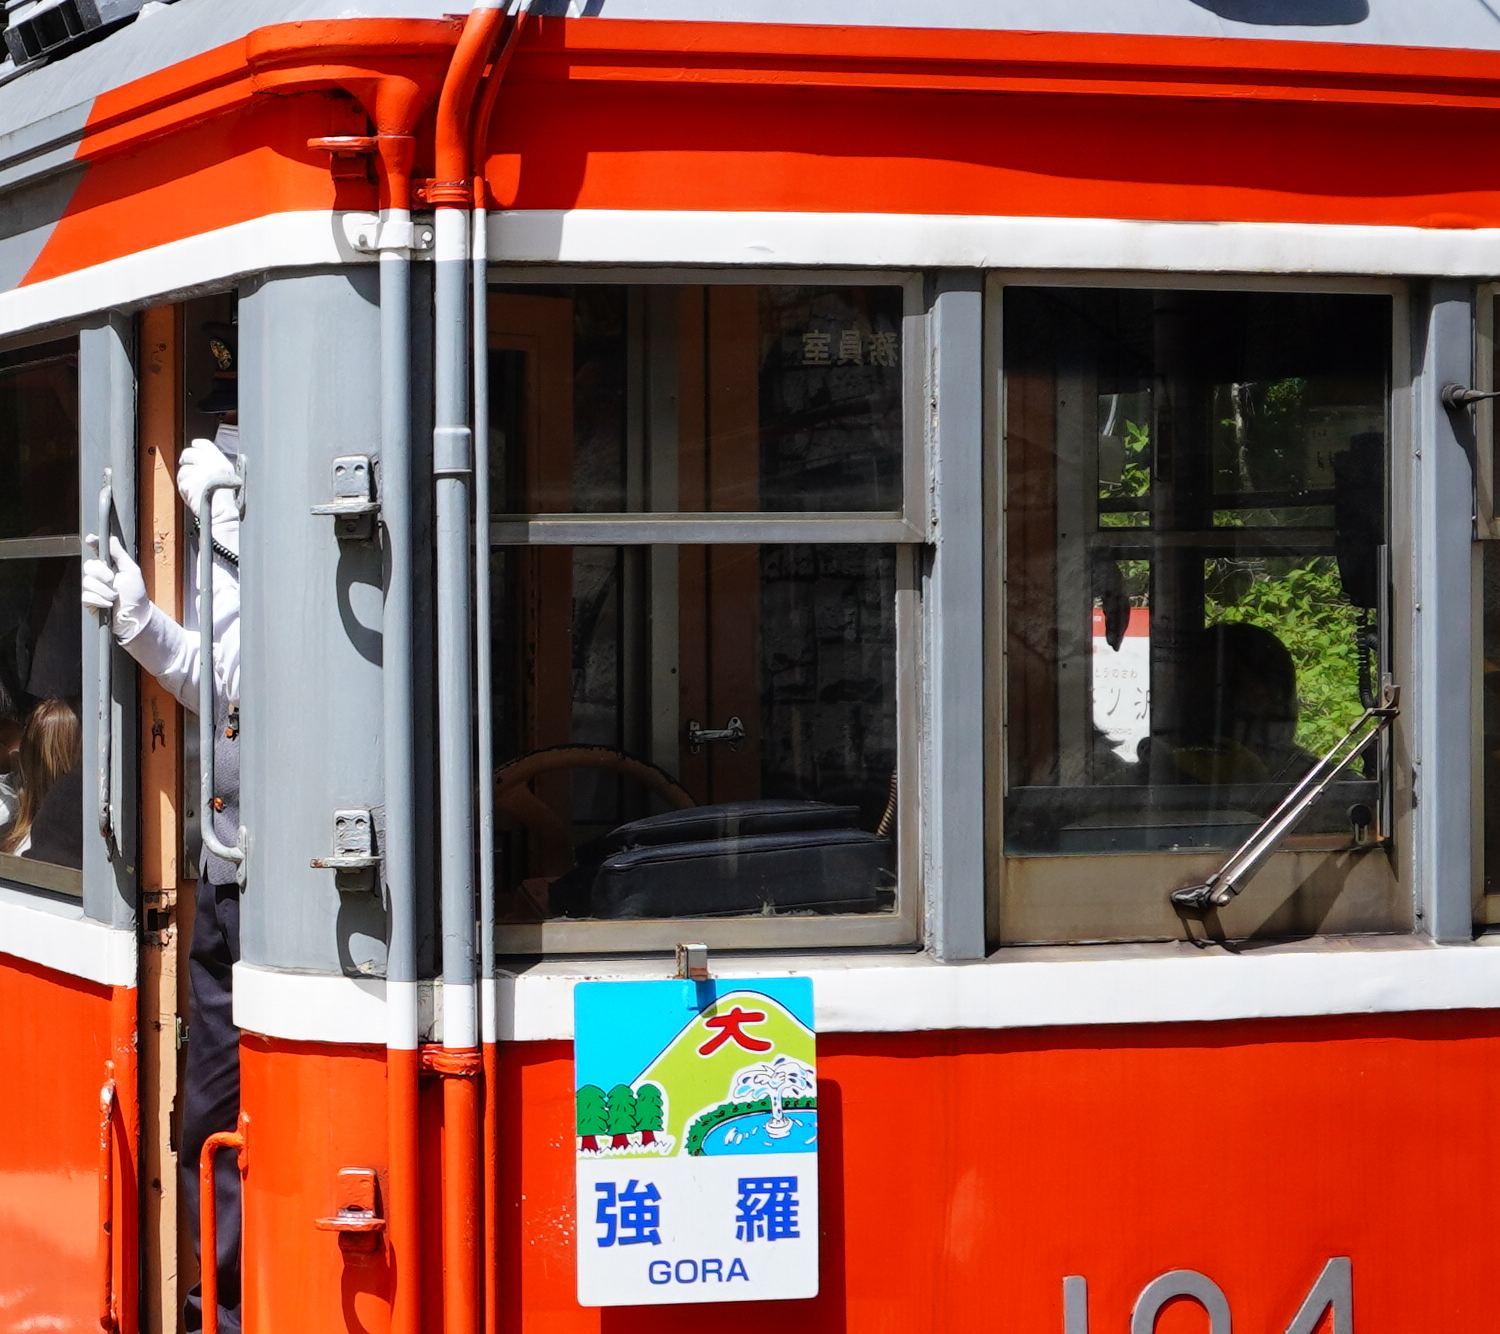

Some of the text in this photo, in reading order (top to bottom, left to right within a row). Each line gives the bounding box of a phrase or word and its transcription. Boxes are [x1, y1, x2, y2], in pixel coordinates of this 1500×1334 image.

[698, 1007, 772, 1056] 大
[595, 1176, 800, 1247] 強羅
[648, 1257, 750, 1285] GORA
